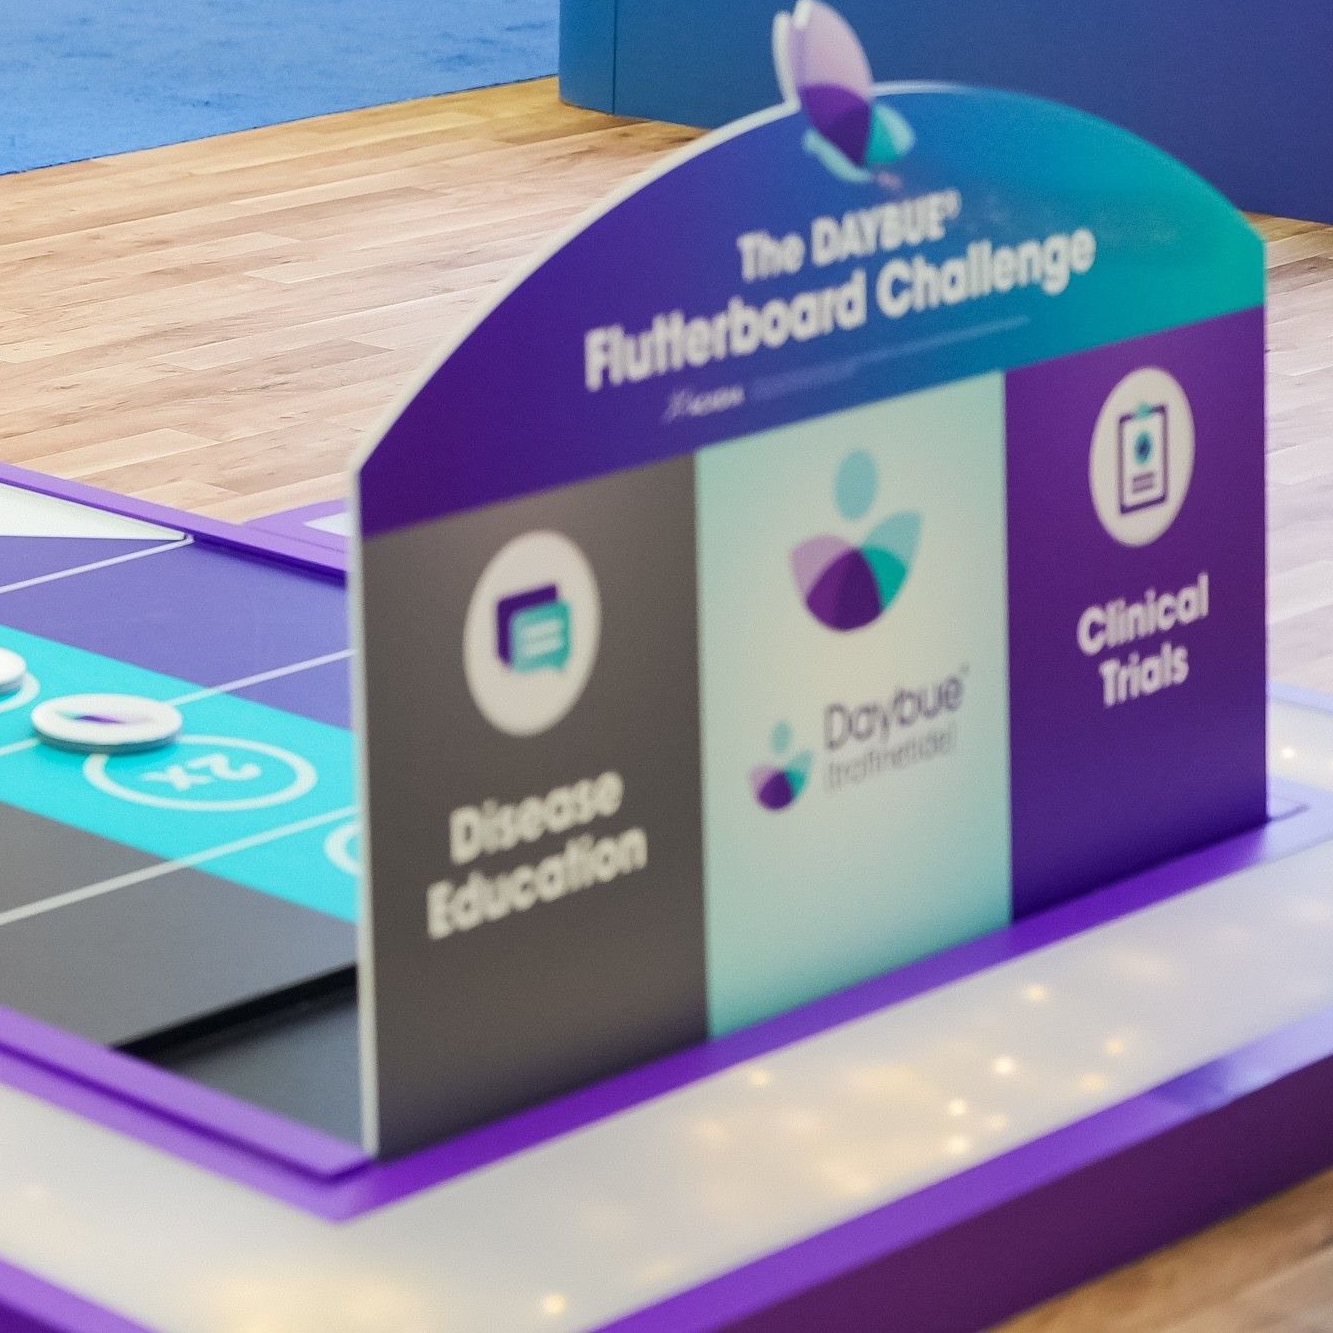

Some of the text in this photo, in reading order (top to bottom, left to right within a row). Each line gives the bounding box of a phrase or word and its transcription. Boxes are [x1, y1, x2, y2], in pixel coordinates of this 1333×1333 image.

[737, 229, 806, 284] The
[584, 268, 867, 393] Flutterboard
[875, 227, 1097, 321] Challenge
[1076, 569, 1211, 657] Clinical
[1098, 640, 1191, 708] Trials
[449, 770, 626, 866] Disease
[426, 826, 650, 941] Education
